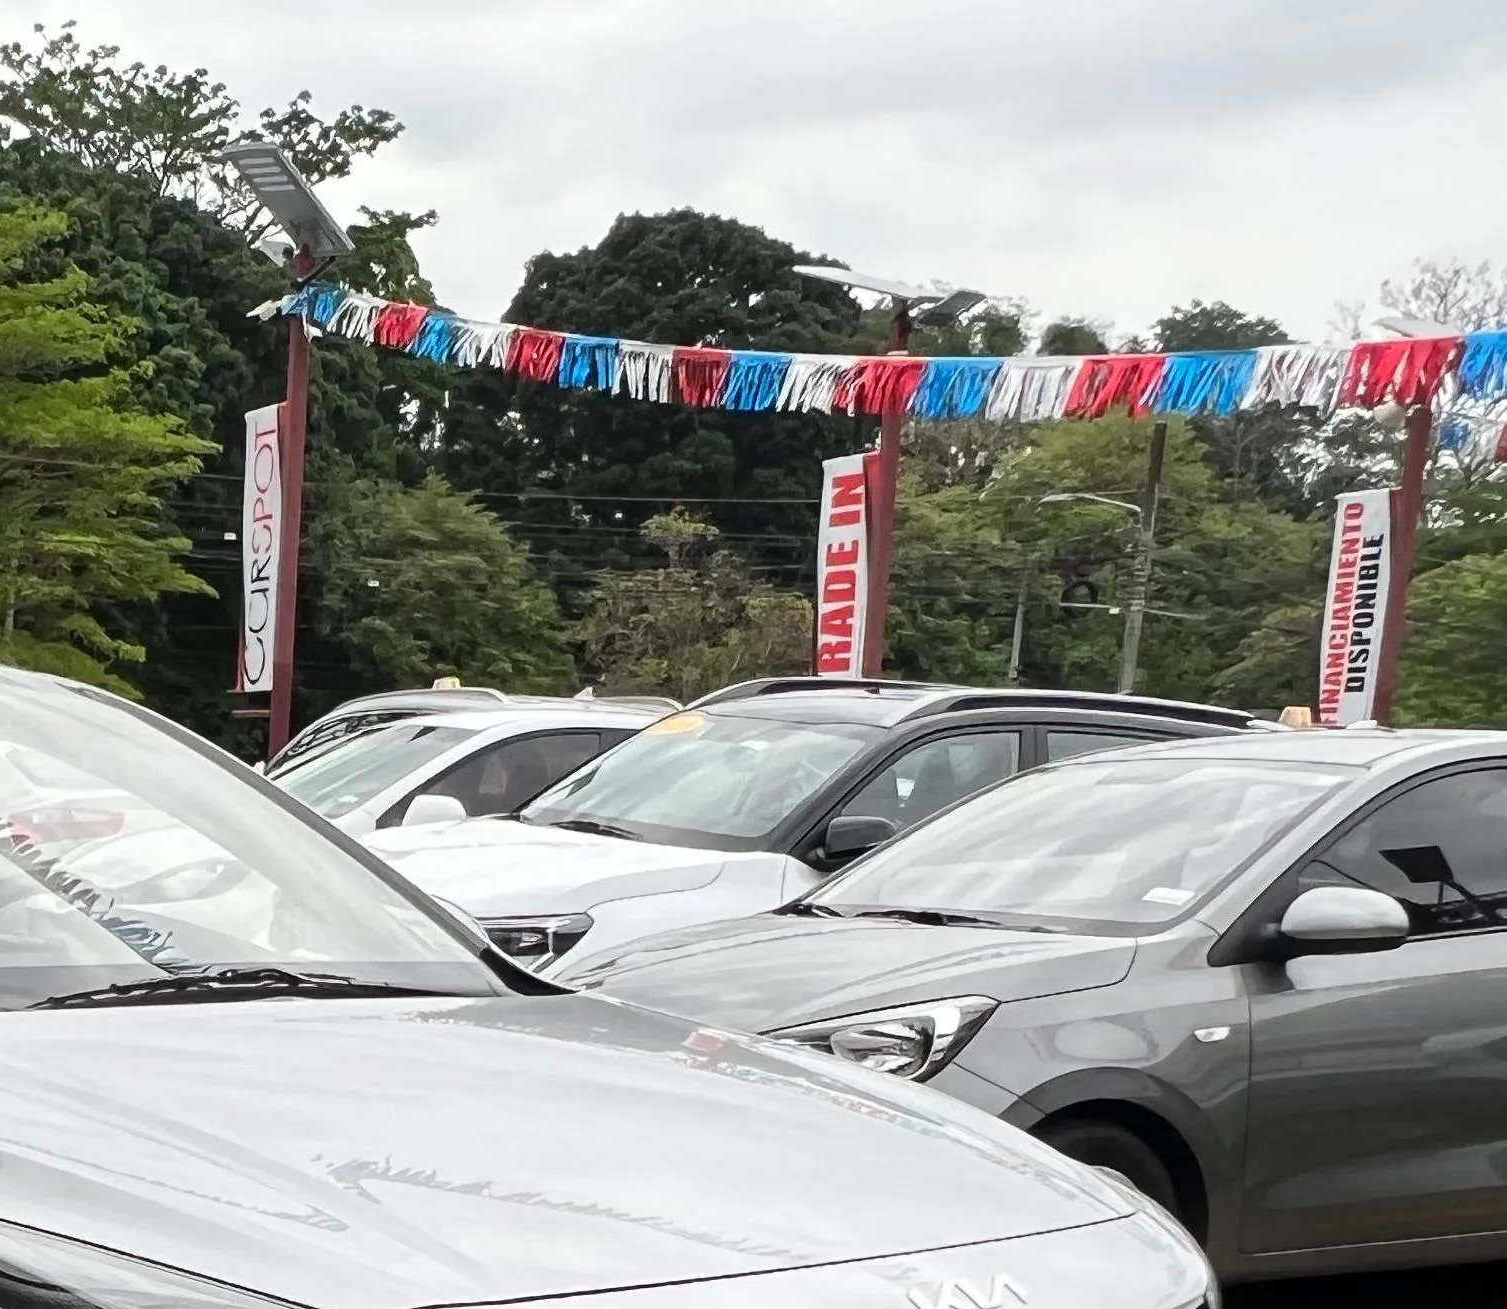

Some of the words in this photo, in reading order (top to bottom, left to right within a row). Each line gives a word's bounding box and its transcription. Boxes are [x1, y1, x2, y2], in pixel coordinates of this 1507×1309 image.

[828, 472, 866, 528] IN
[1320, 502, 1364, 725] FINANCIAMIENTO
[1344, 533, 1385, 693] DISPONIBLE
